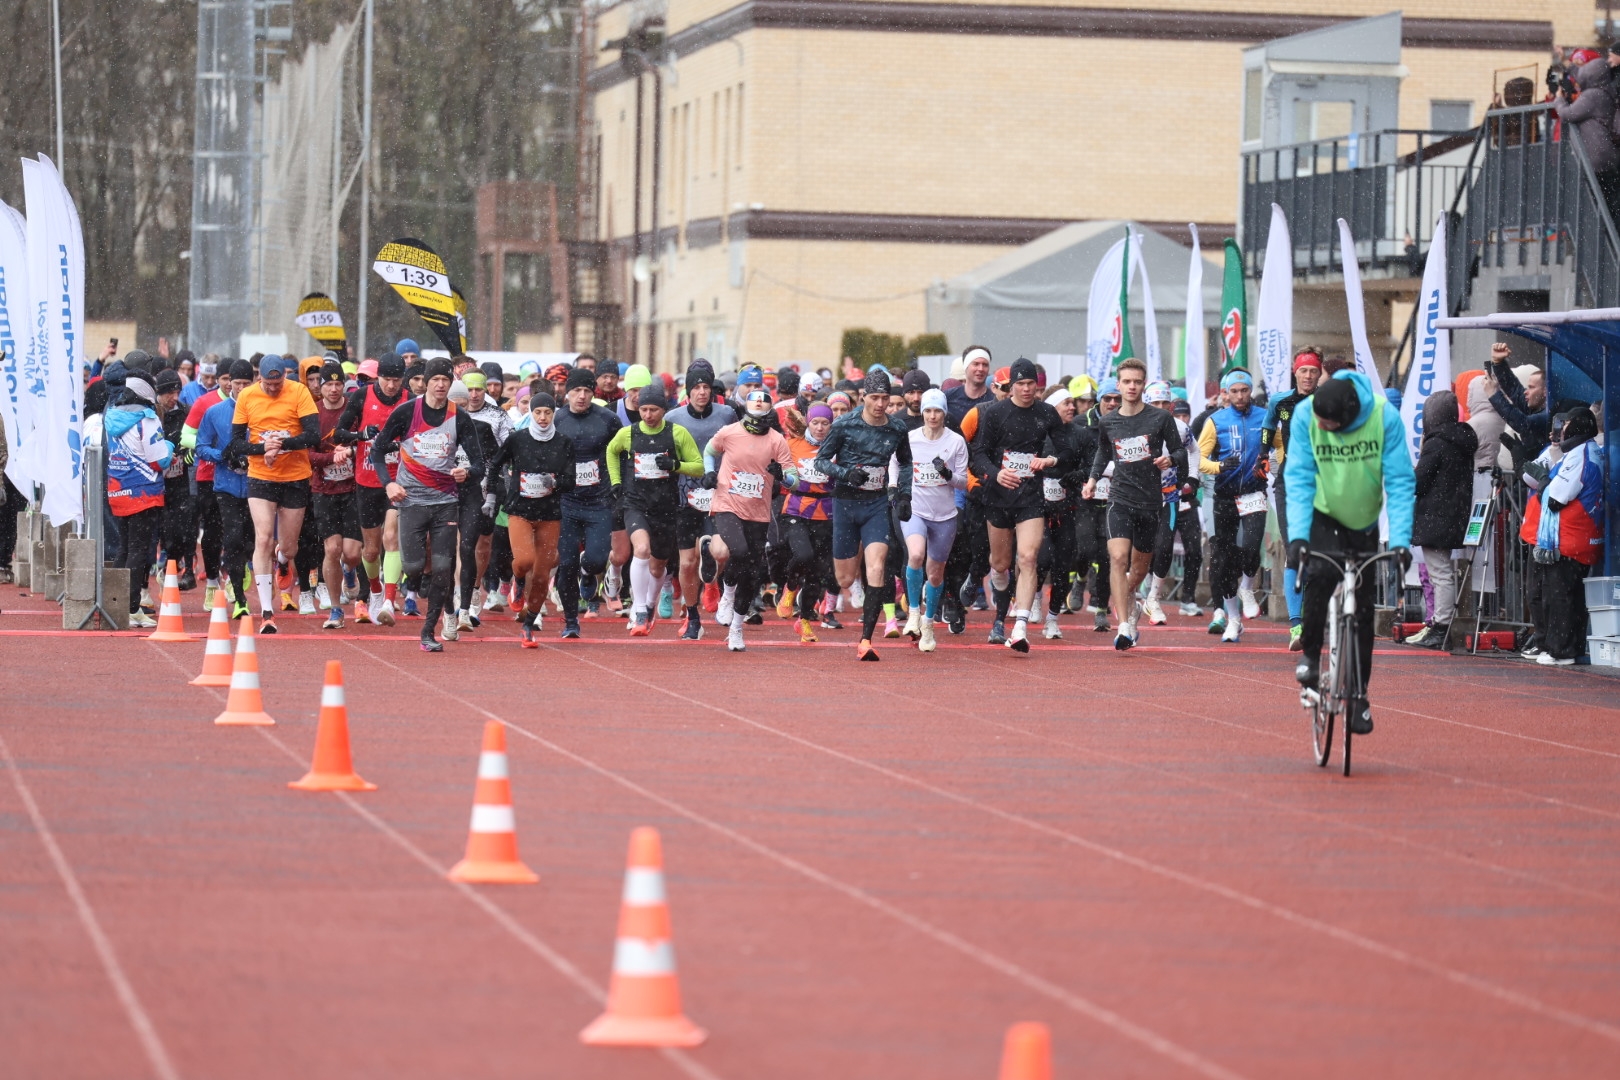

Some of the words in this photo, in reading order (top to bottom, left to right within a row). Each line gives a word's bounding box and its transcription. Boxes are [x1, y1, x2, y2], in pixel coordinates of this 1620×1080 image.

[400, 267, 438, 287] 1:39
[311, 313, 334, 324] 1:59
[1123, 447, 1143, 456] 2079
[1316, 440, 1379, 456] macron
[1009, 461, 1029, 470] 2209
[329, 466, 347, 475] 2119
[920, 472, 940, 480] 2192
[737, 481, 756, 490] 2231
[1045, 486, 1061, 495] 2085
[696, 497, 712, 505] 209
